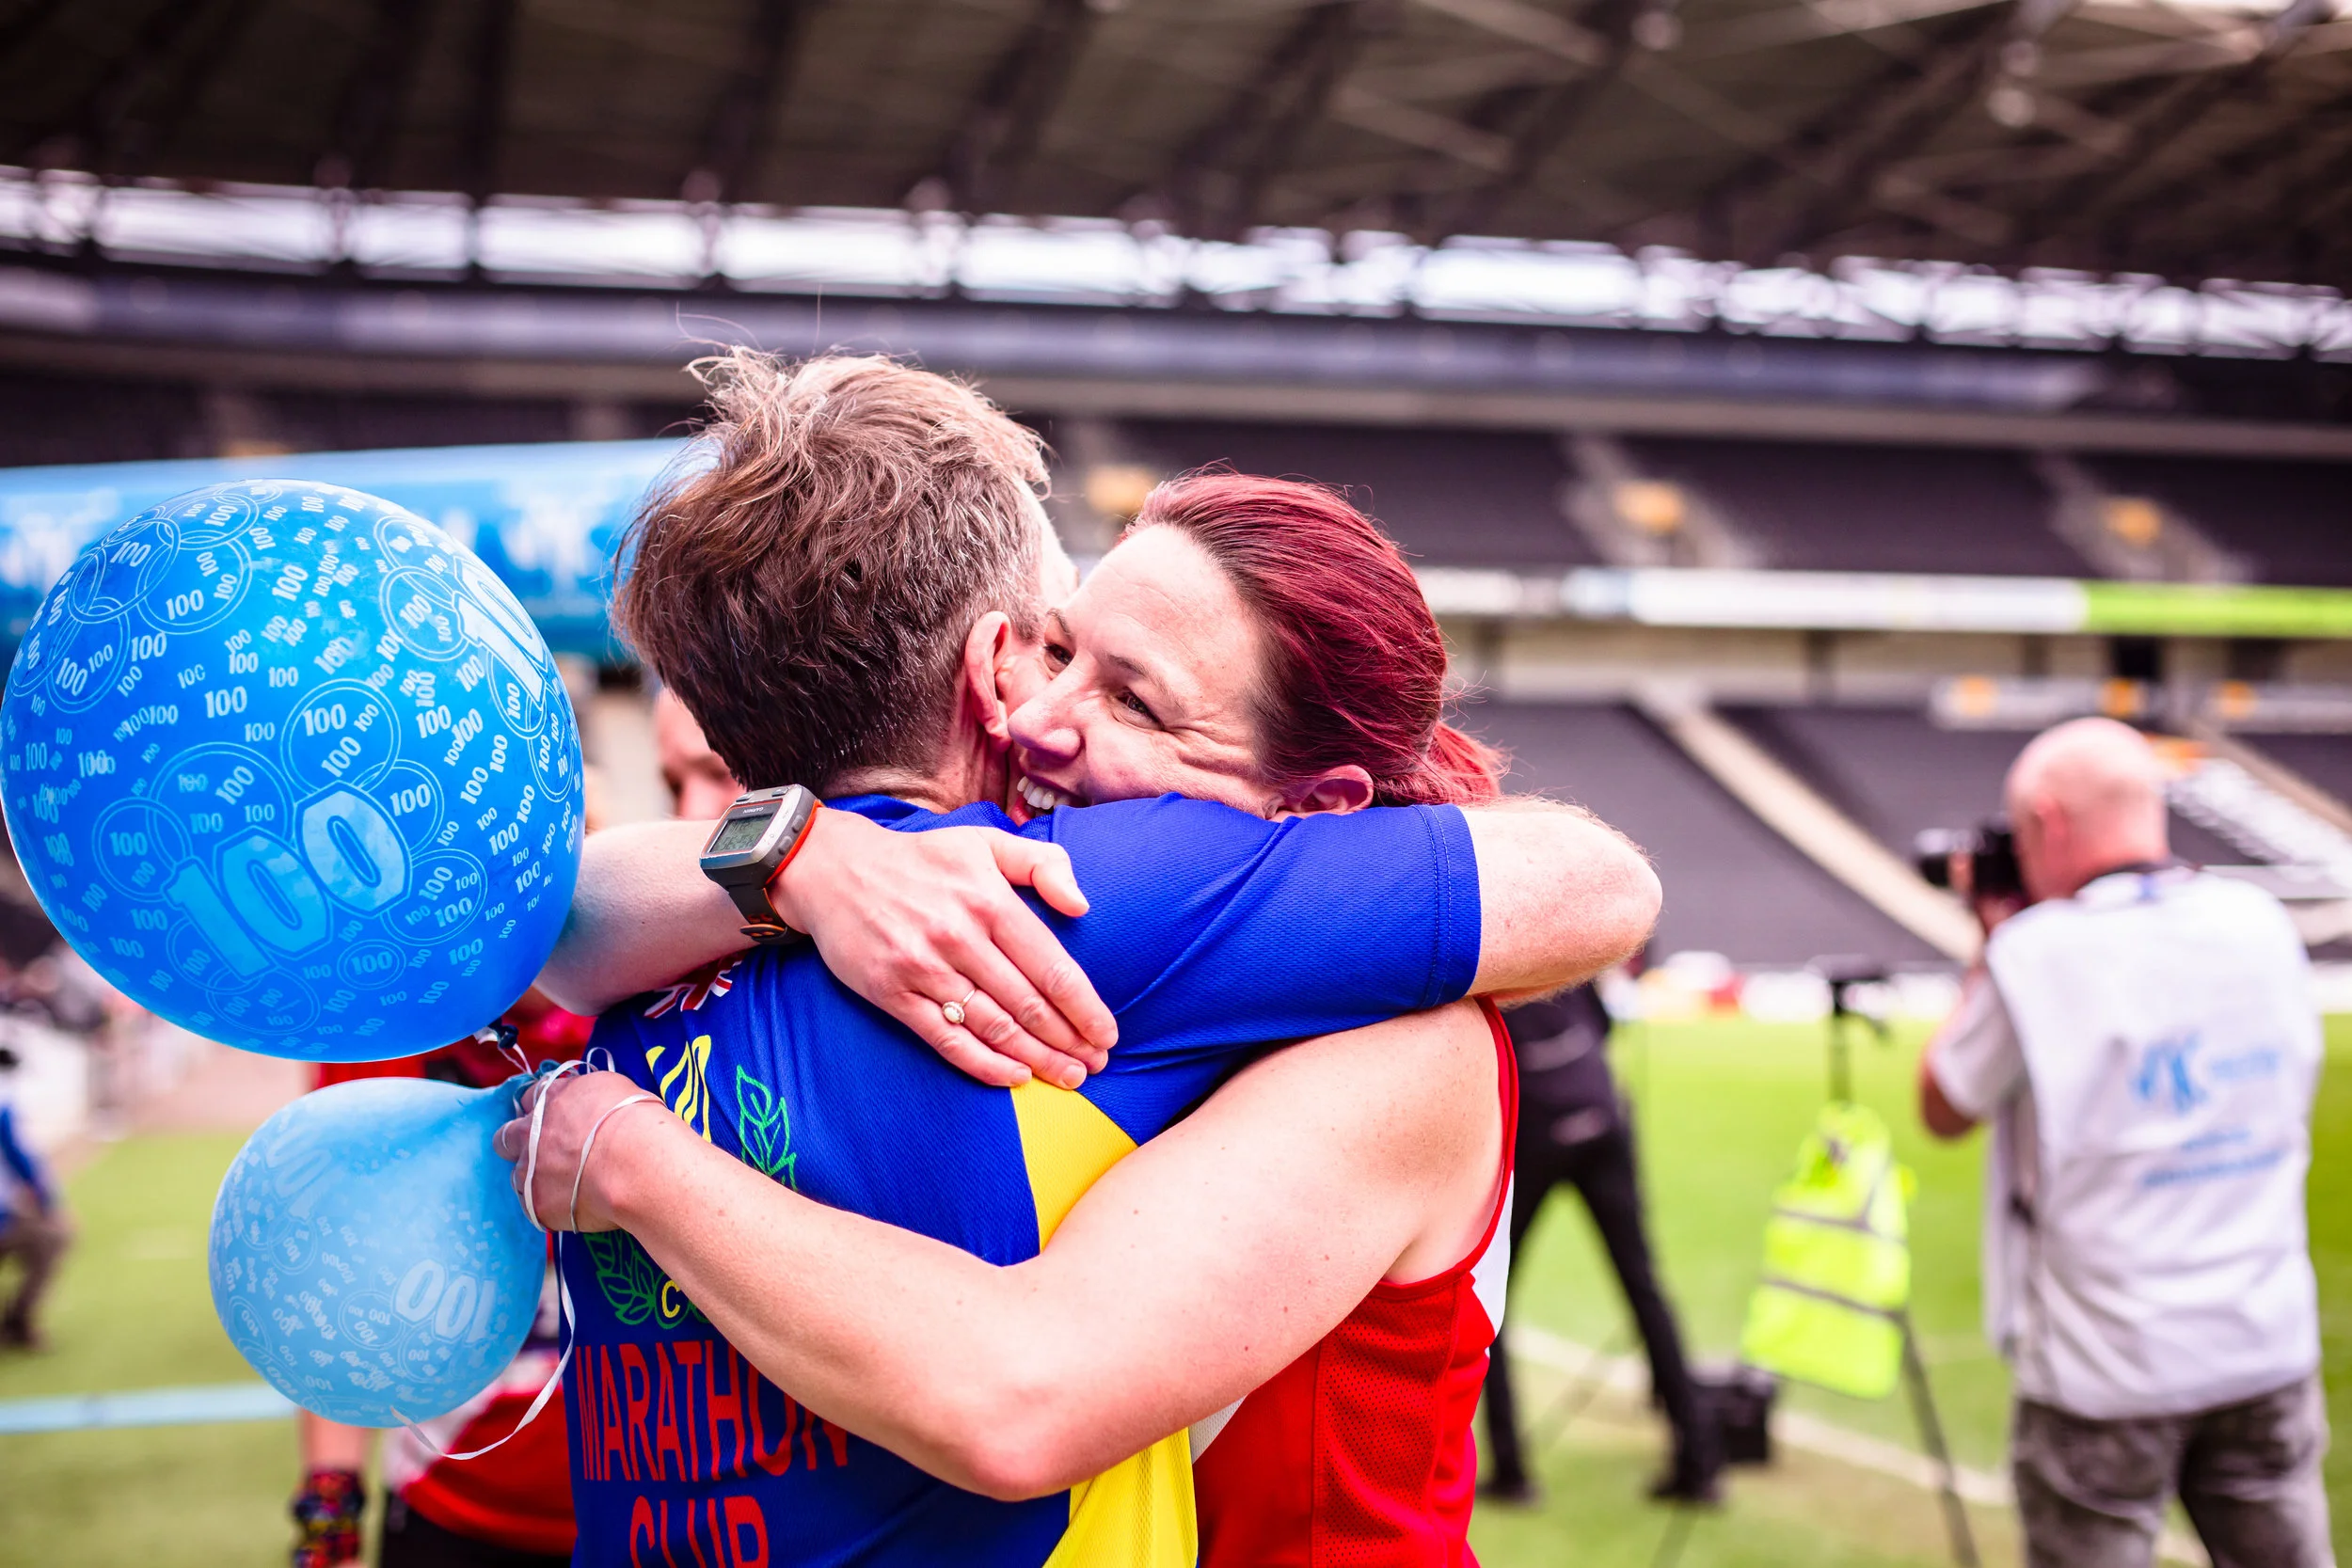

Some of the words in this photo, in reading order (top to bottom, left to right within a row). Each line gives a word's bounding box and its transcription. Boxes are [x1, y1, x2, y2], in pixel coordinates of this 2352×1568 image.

[183, 503, 206, 517] 100
[204, 505, 238, 527] 100
[263, 505, 287, 521] 100
[302, 496, 324, 513] 100
[294, 527, 316, 545] 100
[325, 515, 349, 531] 100
[248, 527, 277, 550] 100
[109, 541, 151, 567] 100
[196, 551, 219, 577] 100
[318, 554, 340, 575] 100
[214, 574, 237, 600] 100
[272, 563, 309, 601] 100
[312, 575, 333, 597] 100
[332, 563, 358, 587] 100
[166, 589, 204, 621] 100
[400, 594, 432, 628] 100
[225, 628, 252, 655] 100
[261, 615, 288, 642] 100
[282, 618, 308, 647] 100
[88, 644, 113, 673] 100
[132, 632, 167, 661] 100
[229, 652, 260, 674] 100
[456, 655, 485, 692] 100
[56, 657, 88, 696] 100
[117, 666, 142, 697] 100
[268, 667, 299, 688] 100
[415, 672, 436, 707] 100
[31, 694, 45, 717] 100
[204, 686, 247, 719] 100
[507, 682, 520, 720] 100
[150, 705, 179, 725] 100
[302, 704, 346, 736] 100
[353, 704, 379, 732] 100
[416, 705, 452, 738] 100
[452, 708, 484, 747] 100
[245, 721, 276, 742] 100
[25, 742, 47, 771] 100
[321, 736, 361, 777] 100
[490, 735, 508, 773] 100
[539, 735, 550, 772] 100
[215, 766, 254, 805] 100
[460, 767, 488, 804] 100
[245, 803, 275, 823] 100
[389, 784, 431, 816] 100
[516, 784, 535, 823] 100
[190, 813, 223, 834] 100
[476, 807, 498, 832] 100
[562, 801, 570, 832] 100
[109, 832, 148, 856] 100
[437, 821, 459, 847] 100
[489, 822, 518, 856] 100
[566, 815, 578, 854] 100
[512, 847, 529, 866] 100
[163, 784, 409, 981] 100
[419, 866, 453, 901] 100
[455, 873, 478, 892] 100
[516, 861, 541, 894] 100
[131, 909, 168, 930] 100
[405, 905, 431, 925] 100
[435, 896, 472, 928] 100
[485, 902, 505, 921] 100
[339, 920, 363, 942] 100
[499, 919, 516, 939] 100
[108, 937, 145, 958] 100
[408, 948, 432, 968] 100
[448, 938, 484, 965] 100
[303, 964, 332, 979] 100
[352, 951, 393, 975] 100
[461, 959, 482, 976] 100
[324, 990, 357, 1013] 100
[379, 990, 407, 1006] 100
[418, 981, 450, 1004] 100
[392, 1259, 497, 1343] 100
